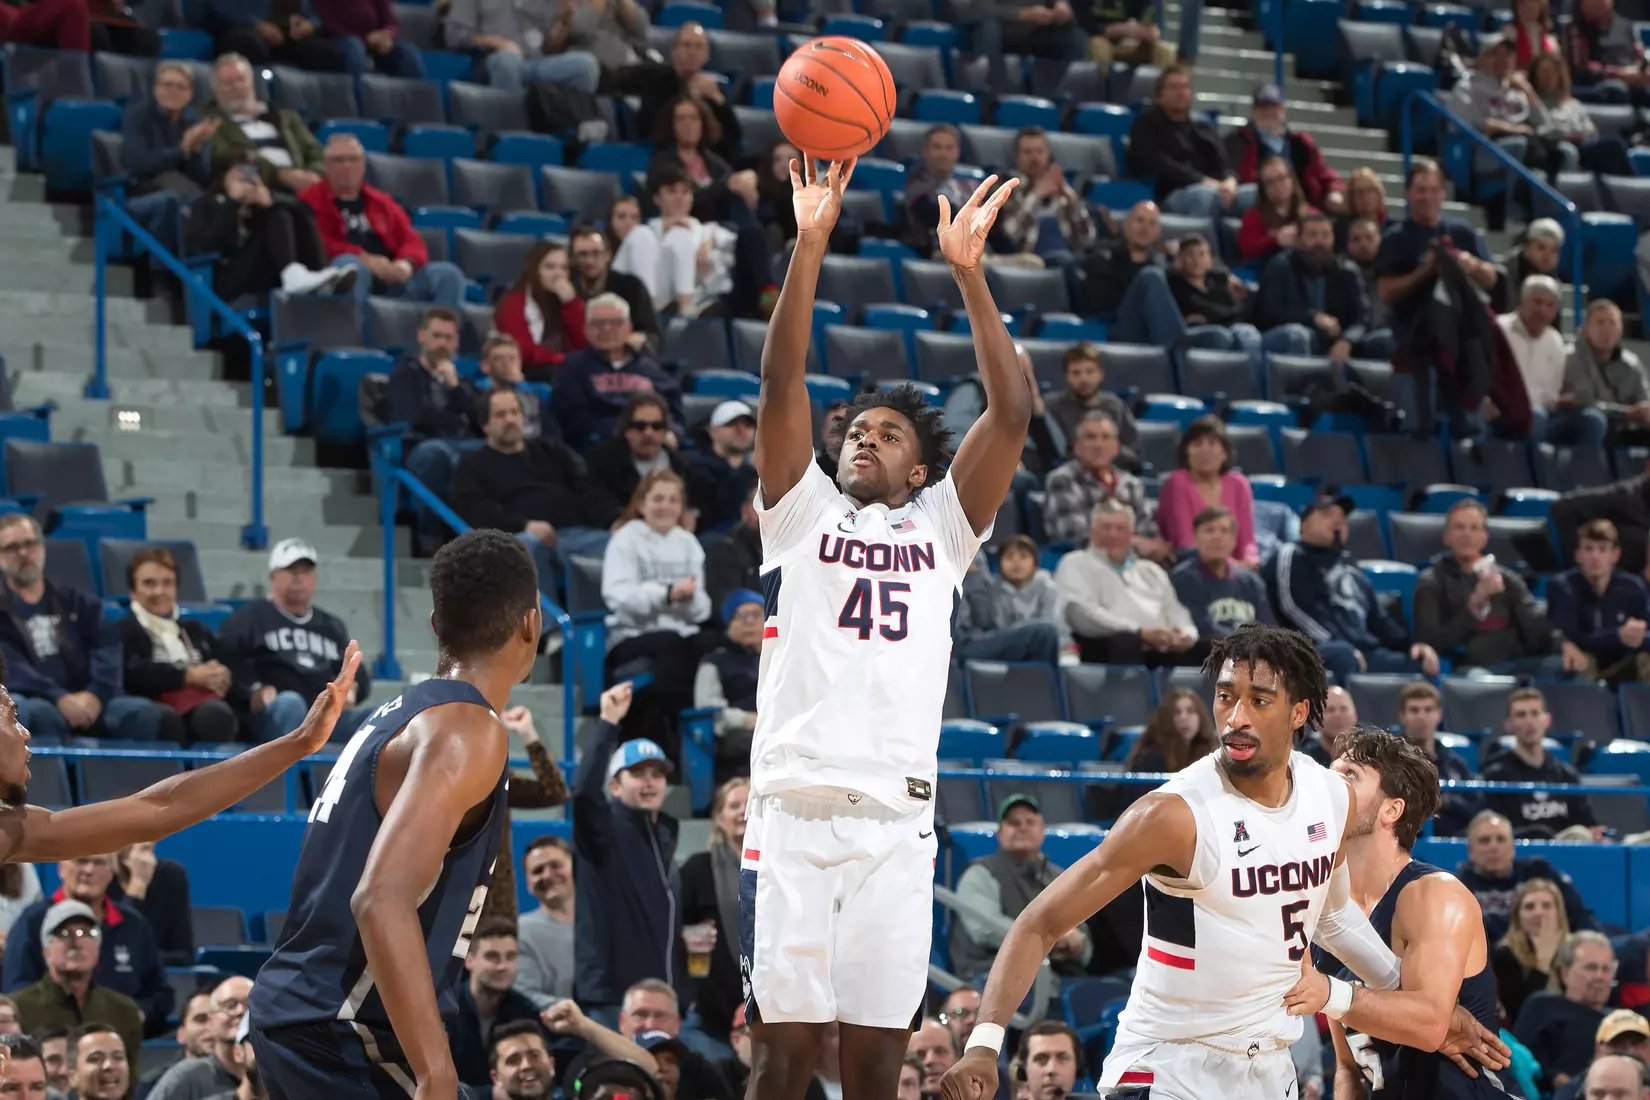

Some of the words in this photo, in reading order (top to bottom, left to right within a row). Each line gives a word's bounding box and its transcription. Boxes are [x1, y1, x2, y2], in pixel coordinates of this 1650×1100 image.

[794, 72, 829, 97] UCONN
[819, 533, 935, 573] UCONN
[838, 577, 911, 642] 45
[264, 627, 339, 661] UCONN
[1231, 851, 1335, 898] UCONN
[1281, 899, 1310, 962] 5
[1345, 1033, 1384, 1091] 5
